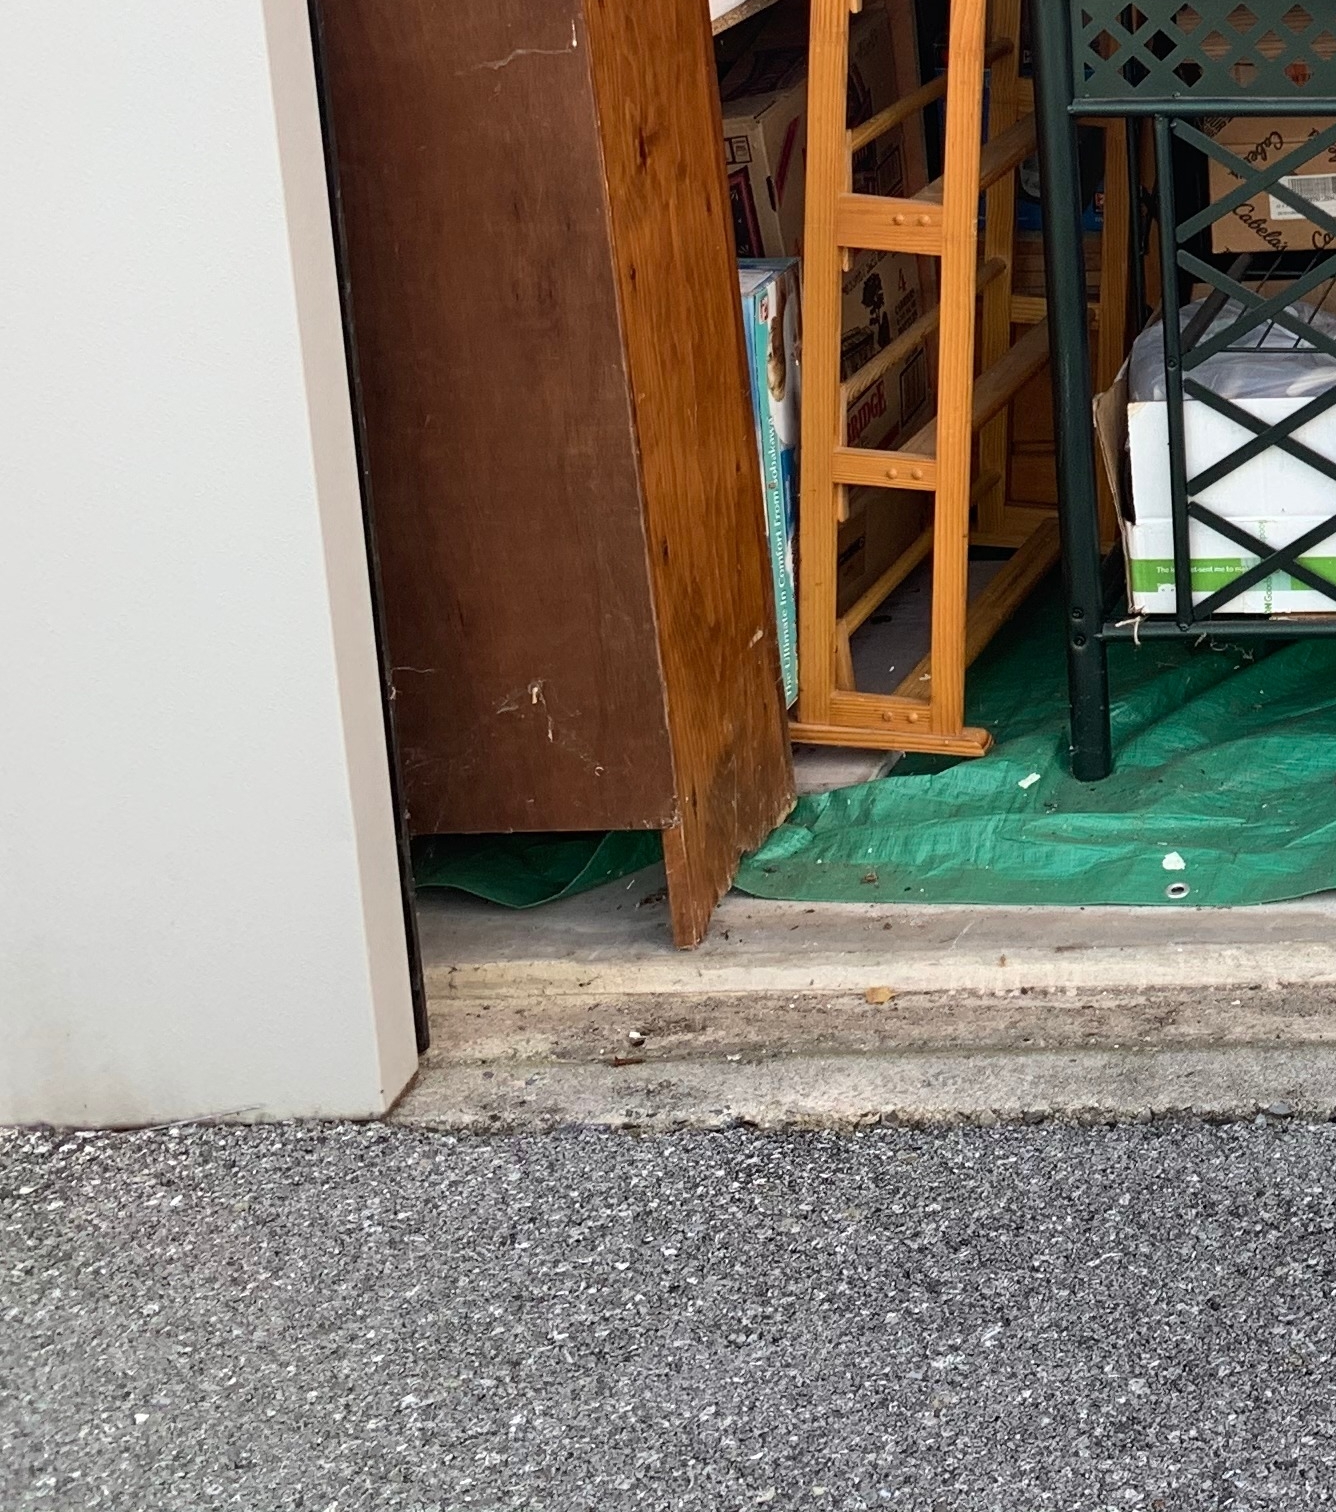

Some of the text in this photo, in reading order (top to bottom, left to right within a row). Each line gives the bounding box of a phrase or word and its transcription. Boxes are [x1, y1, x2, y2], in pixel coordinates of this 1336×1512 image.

[771, 490, 782, 527] From
[773, 529, 786, 588] Comfort
[779, 607, 792, 669] Ultimate
